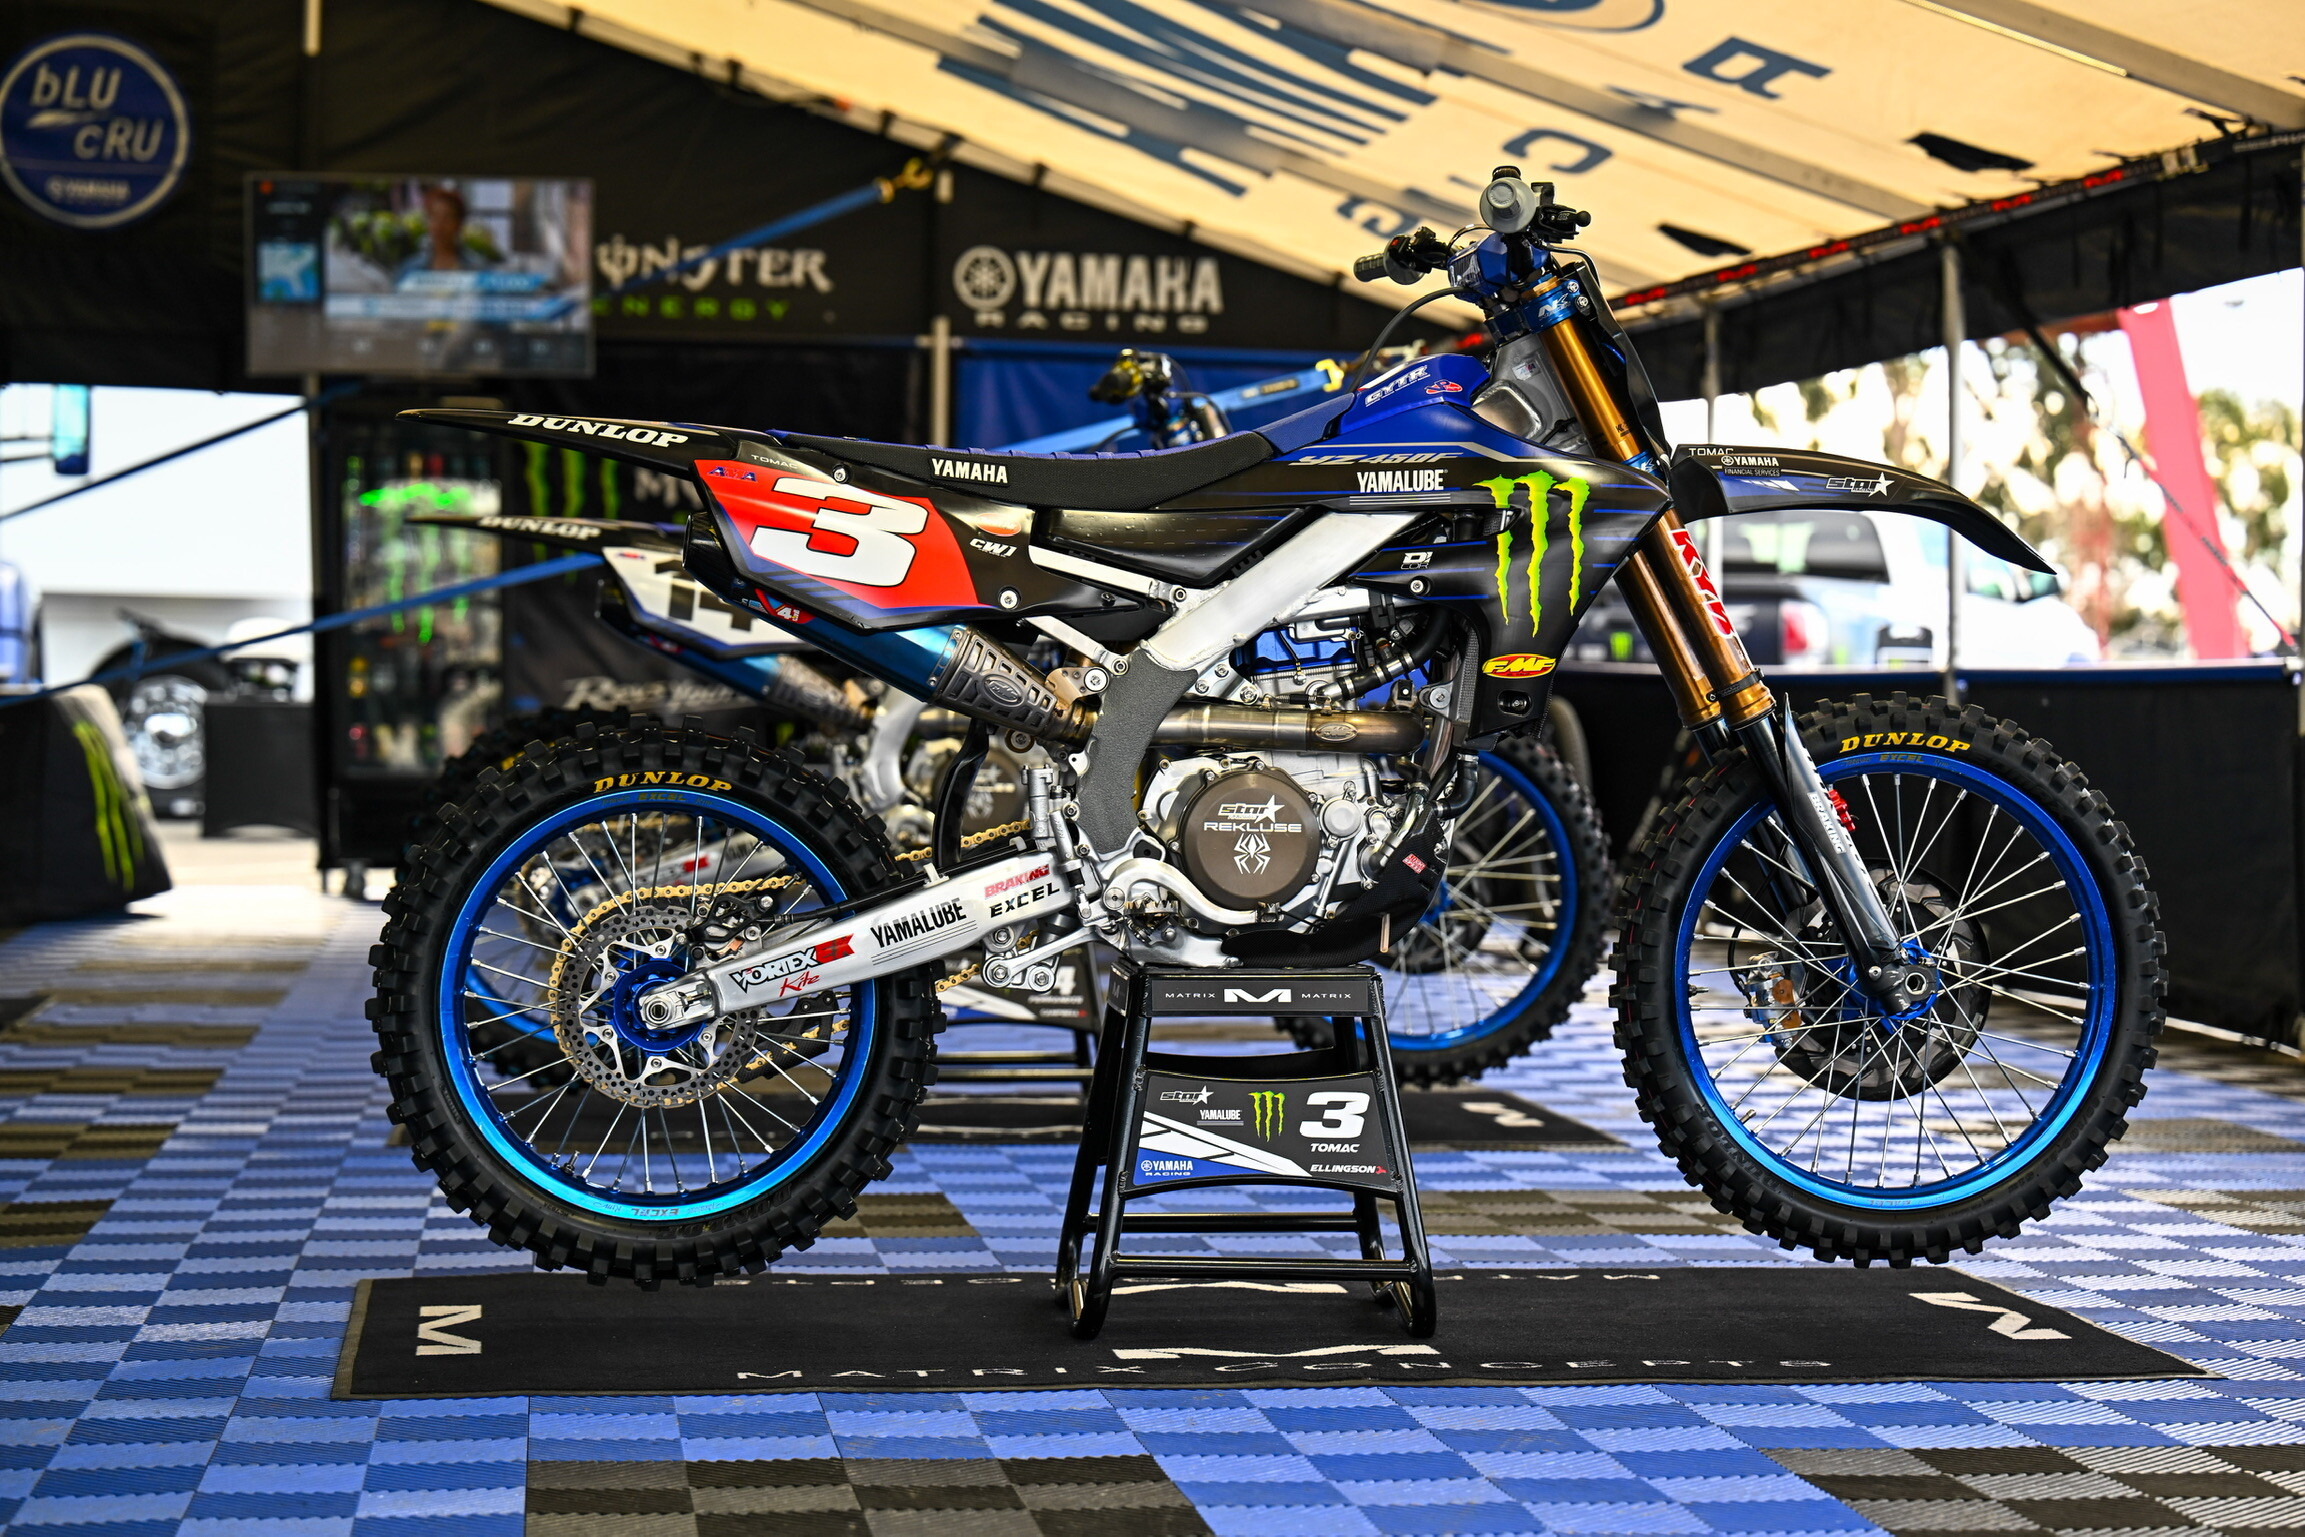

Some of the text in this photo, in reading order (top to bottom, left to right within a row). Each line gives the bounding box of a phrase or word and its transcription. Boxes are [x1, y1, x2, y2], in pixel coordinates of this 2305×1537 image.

[597, 233, 834, 294] ONSTER
[1014, 250, 1224, 315] YAMAHA
[973, 310, 1209, 334] RACING
[507, 413, 689, 448] DUNLOP
[751, 454, 799, 469] TOMAC
[1689, 447, 1734, 457] TOMAC
[1733, 455, 1780, 467] YAMAHA
[931, 458, 1009, 484] YAMAHA
[1356, 469, 1445, 494] YAMALUBE
[1724, 468, 1781, 477] FINANCIAL SERVICES
[477, 515, 602, 541] DUNLOP
[750, 477, 929, 587] 3
[1483, 656, 1556, 674] FMF
[1839, 732, 1971, 754] DUNLOP
[593, 771, 733, 793] DUNLOP
[638, 792, 687, 801] EXCEL
[1203, 821, 1302, 833] REKLUSE
[1808, 793, 1845, 854] BRAKING
[984, 864, 1051, 898] BRAKING
[989, 882, 1060, 919] EXCEL
[870, 897, 968, 948] YAMALUBE
[728, 945, 820, 993] VORTEX
[1200, 1109, 1242, 1120] YAMALUBE
[1300, 1091, 1370, 1138] 3
[1310, 1143, 1360, 1153] TOMAC
[1152, 1160, 1193, 1171] YAMAHA
[1310, 1164, 1376, 1174] ELLINGSON
[415, 1304, 482, 1357] M
[736, 1364, 1147, 1381] MATRIX
